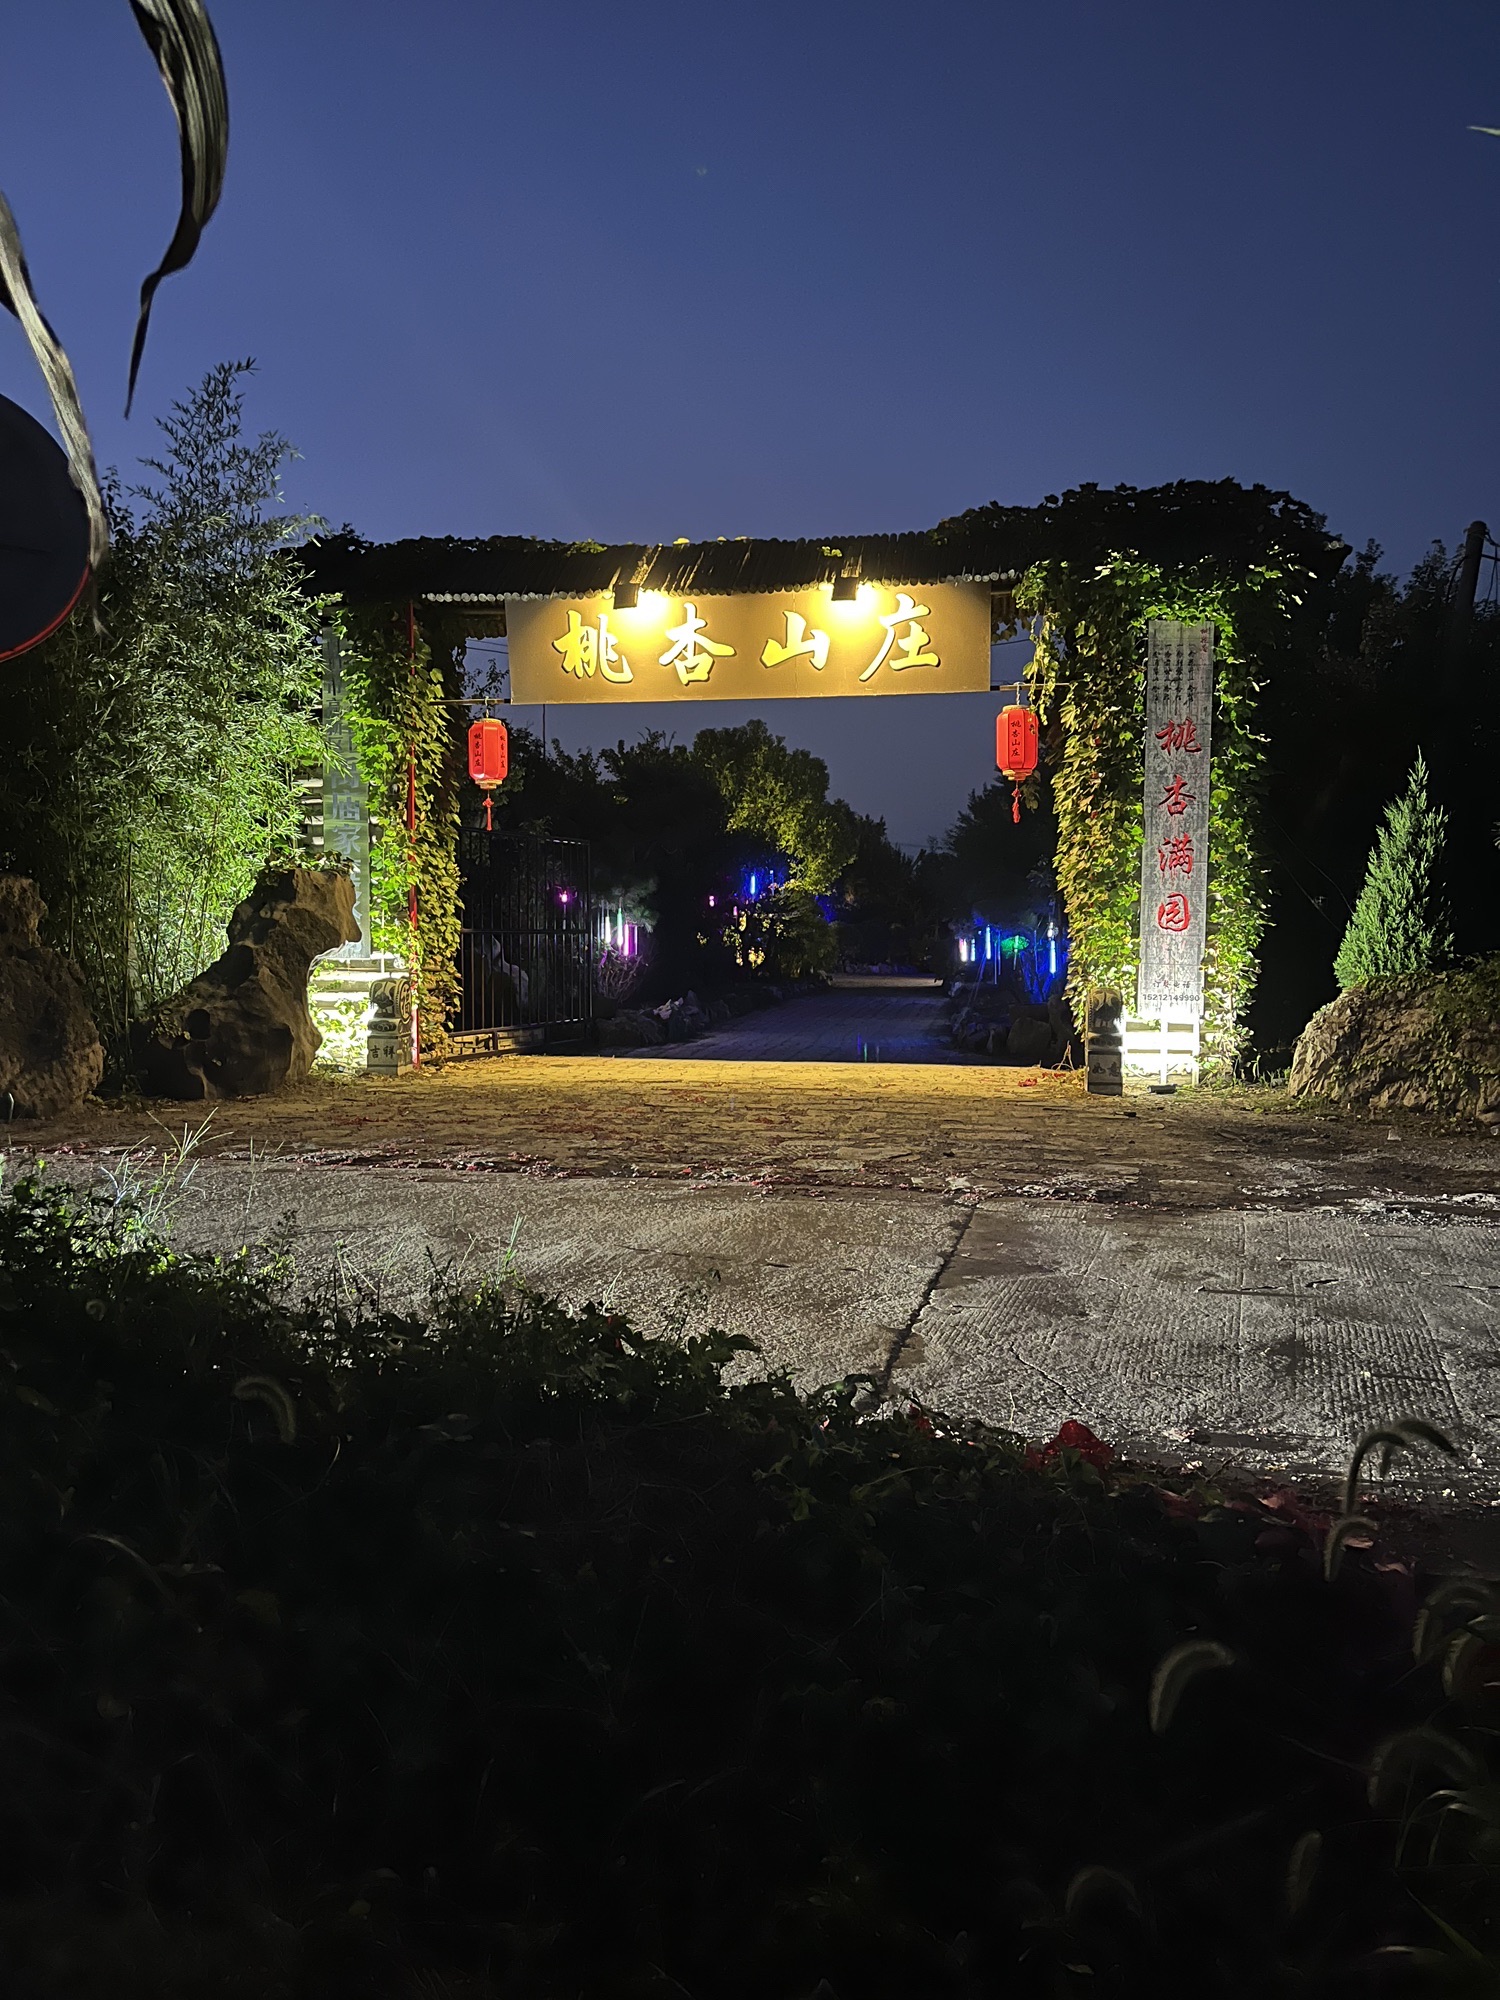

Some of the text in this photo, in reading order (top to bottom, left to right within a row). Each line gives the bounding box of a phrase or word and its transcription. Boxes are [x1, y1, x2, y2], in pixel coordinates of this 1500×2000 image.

[553, 593, 941, 685] 桃杏山庄
[473, 732, 483, 767] 桃杏山庄
[1010, 720, 1022, 757] 桃杏山庄
[1155, 716, 1203, 932] 桃杏满园
[1142, 993, 1201, 1002] 15212149990
[370, 1044, 396, 1060] 吉祥
